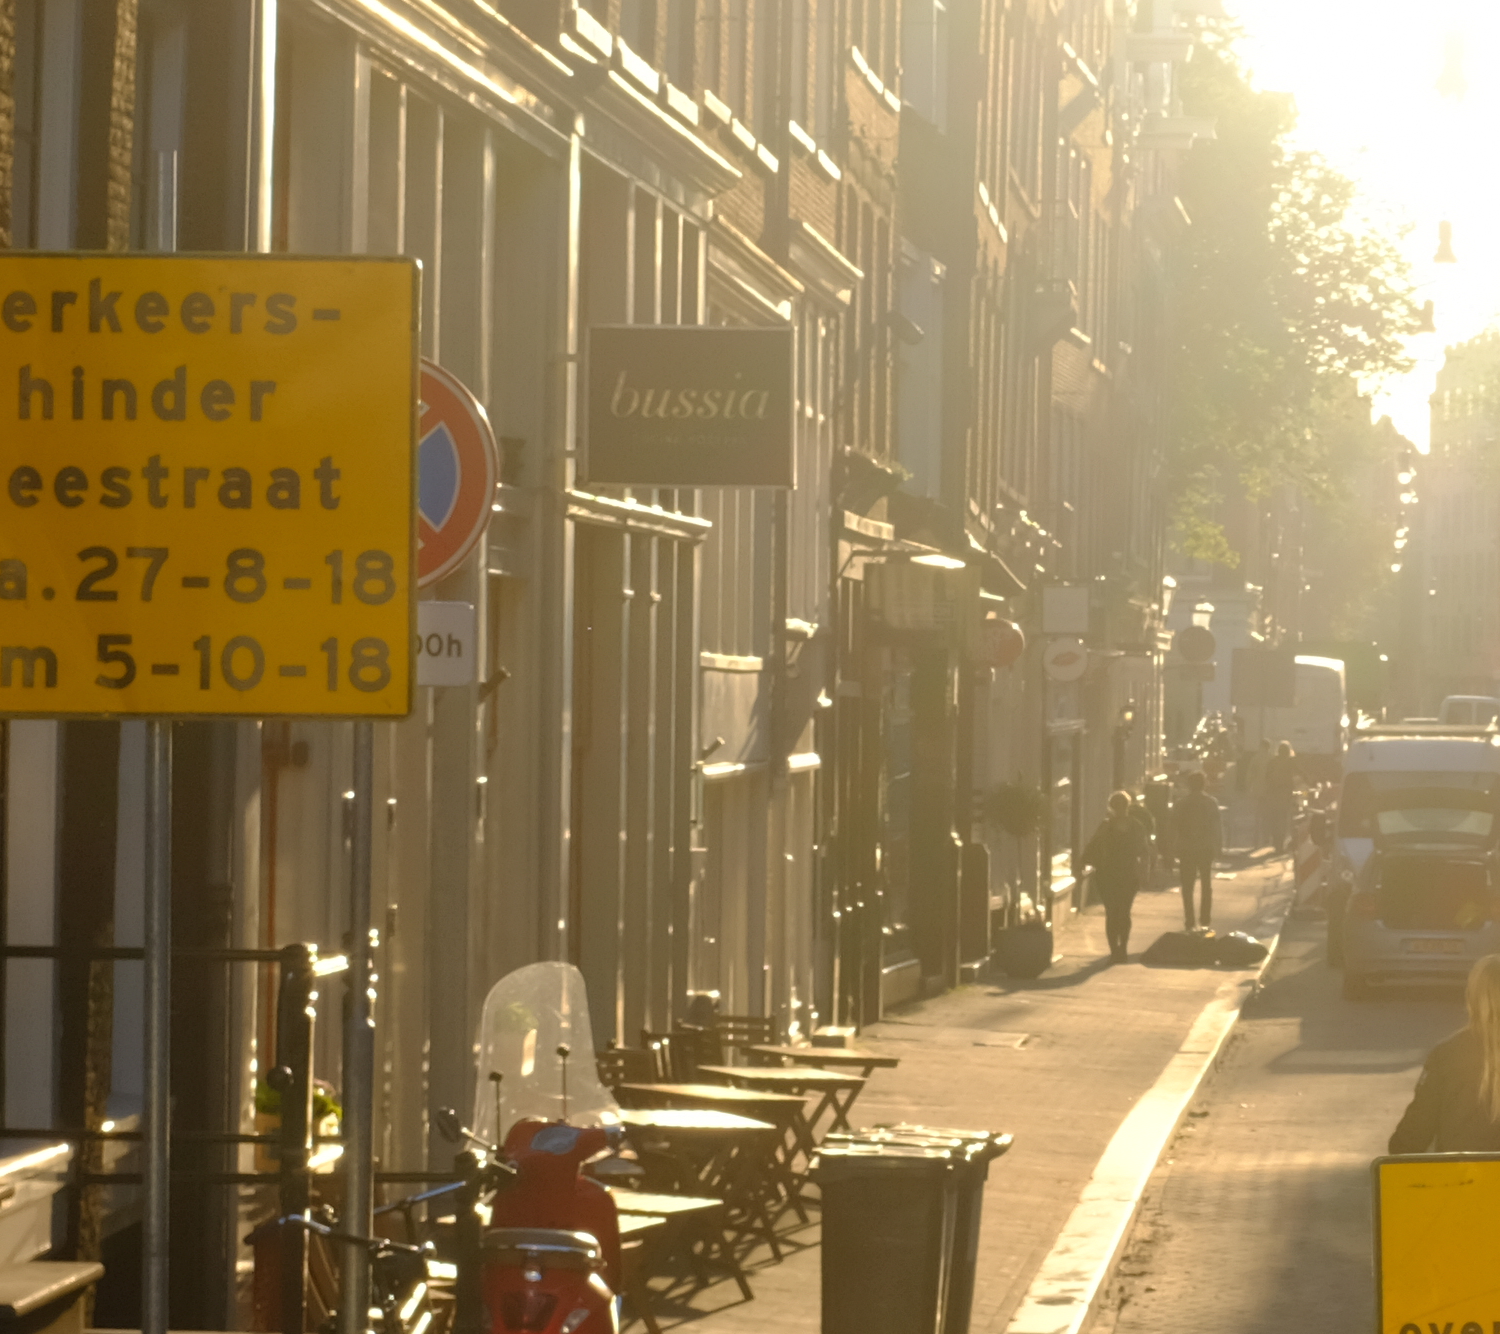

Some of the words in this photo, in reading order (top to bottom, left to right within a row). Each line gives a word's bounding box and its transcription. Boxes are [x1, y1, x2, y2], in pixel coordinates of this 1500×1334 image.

[17, 363, 278, 422] hinder
[610, 370, 771, 420] bussia
[94, 633, 392, 693] 5-10-18
